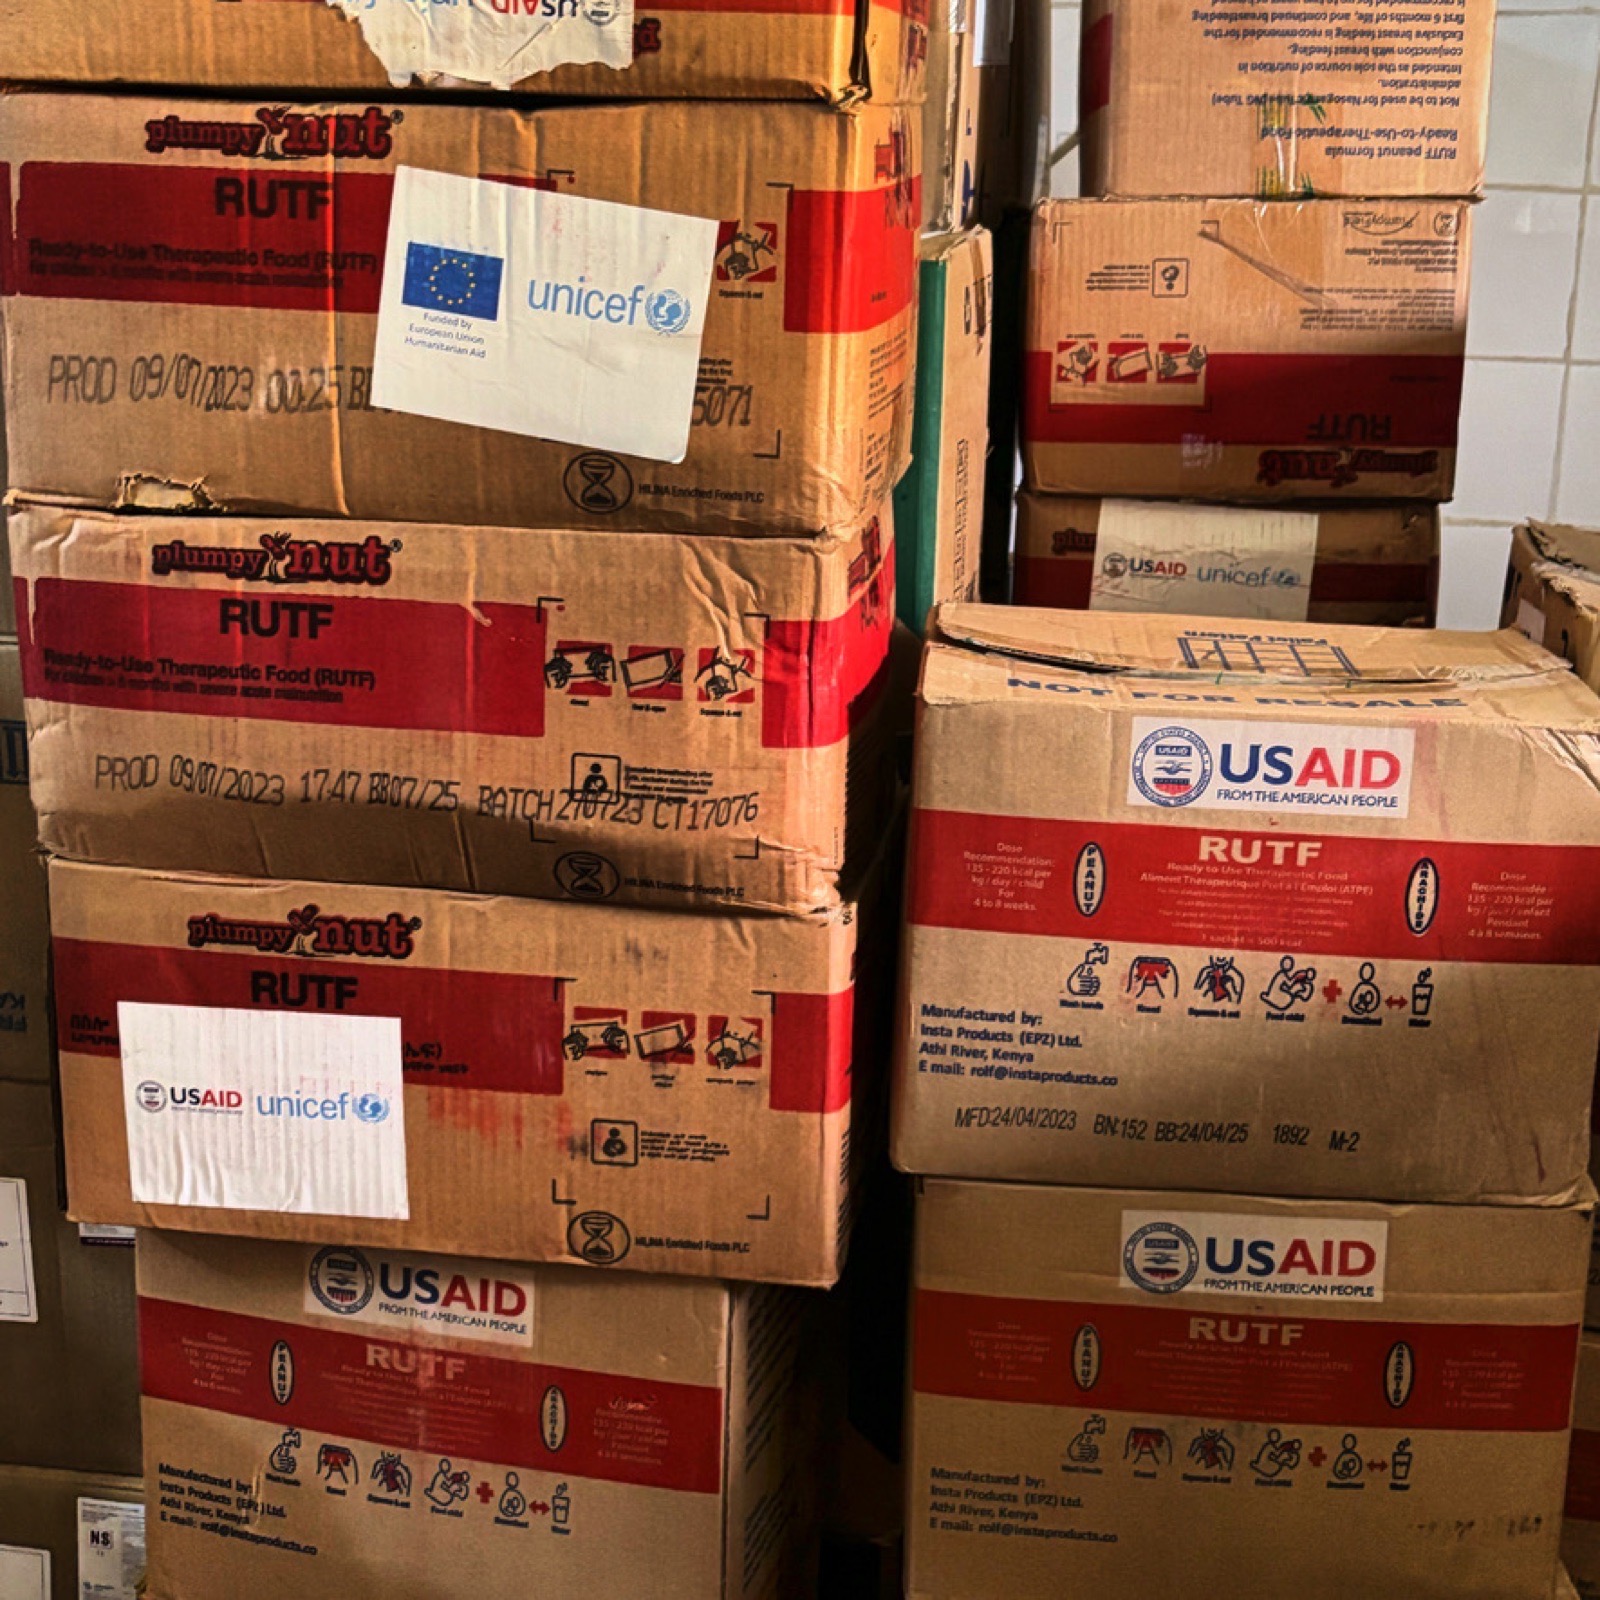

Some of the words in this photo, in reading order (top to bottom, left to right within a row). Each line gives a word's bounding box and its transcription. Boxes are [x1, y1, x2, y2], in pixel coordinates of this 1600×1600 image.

[145, 115, 264, 156] plumpy
[281, 105, 393, 159] nut
[215, 177, 331, 220] RUTF
[527, 274, 646, 327] unicef
[408, 322, 454, 341] European
[456, 330, 485, 345] Union
[423, 311, 459, 329] Funded
[460, 318, 473, 332] by
[404, 335, 468, 357] Humanitarian
[469, 347, 487, 359] Aid
[48, 353, 118, 404] PROD
[1307, 413, 1392, 442] RUTF
[714, 487, 743, 502] Foods
[744, 489, 765, 504] PLC
[152, 539, 266, 581] plumpy
[285, 535, 392, 585] nut
[1130, 557, 1187, 577] USAID
[1196, 561, 1271, 588] unicef
[219, 597, 335, 640] RUTF
[157, 657, 261, 682] Therapeutic
[266, 665, 310, 685] Food
[314, 668, 376, 692] (RUTF)
[1007, 677, 1113, 697] NOT
[1132, 691, 1236, 703] FOR
[1255, 697, 1468, 708] RESALE
[1219, 743, 1402, 790] USAID
[95, 754, 159, 791] PROD
[169, 754, 286, 807] 09/07/2023
[477, 785, 555, 822] BATCH
[652, 790, 760, 831] CT17076
[1216, 788, 1253, 802] FROM
[1254, 789, 1280, 803] THE
[1280, 791, 1348, 806] AMERICAN
[1350, 794, 1398, 808] PEOPLE
[1199, 836, 1323, 868] RUTF
[1083, 844, 1096, 913] PEANUT
[187, 911, 291, 951] plumpy
[314, 911, 415, 959] nut
[250, 970, 358, 1010] RUTF
[921, 1003, 1016, 1024] Manufactured
[1020, 1010, 1043, 1027] by:
[920, 1023, 953, 1038] Insta
[956, 1026, 1014, 1043] Products
[1019, 1031, 1056, 1048] (EPZ)
[1058, 1034, 1083, 1048] Ltd.
[918, 1059, 928, 1072] E
[930, 1061, 965, 1076] mail:
[919, 1041, 947, 1056] Athi
[951, 1044, 989, 1062] River,
[992, 1047, 1035, 1065] Kenya
[169, 1087, 243, 1109] USAID
[256, 1089, 350, 1120] unicef
[1272, 1124, 1310, 1147] 1892
[732, 1241, 750, 1254] PLC
[1205, 1236, 1377, 1278] USAID
[379, 1262, 528, 1318] USAID
[1204, 1277, 1241, 1290] FROM
[1242, 1280, 1266, 1292] THE
[1266, 1282, 1328, 1296] AMERICAN
[1330, 1284, 1375, 1298] PEOPLE
[378, 1301, 407, 1318] FROM
[408, 1306, 430, 1321] THE
[430, 1310, 487, 1329] AMERICAN
[488, 1317, 527, 1336] PEOPLE
[1188, 1316, 1305, 1346] RUTF
[366, 1343, 467, 1381] RUTF
[930, 1466, 1020, 1486] Manufactured
[963, 1487, 1019, 1504] Products
[998, 1507, 1039, 1522] Kenya
